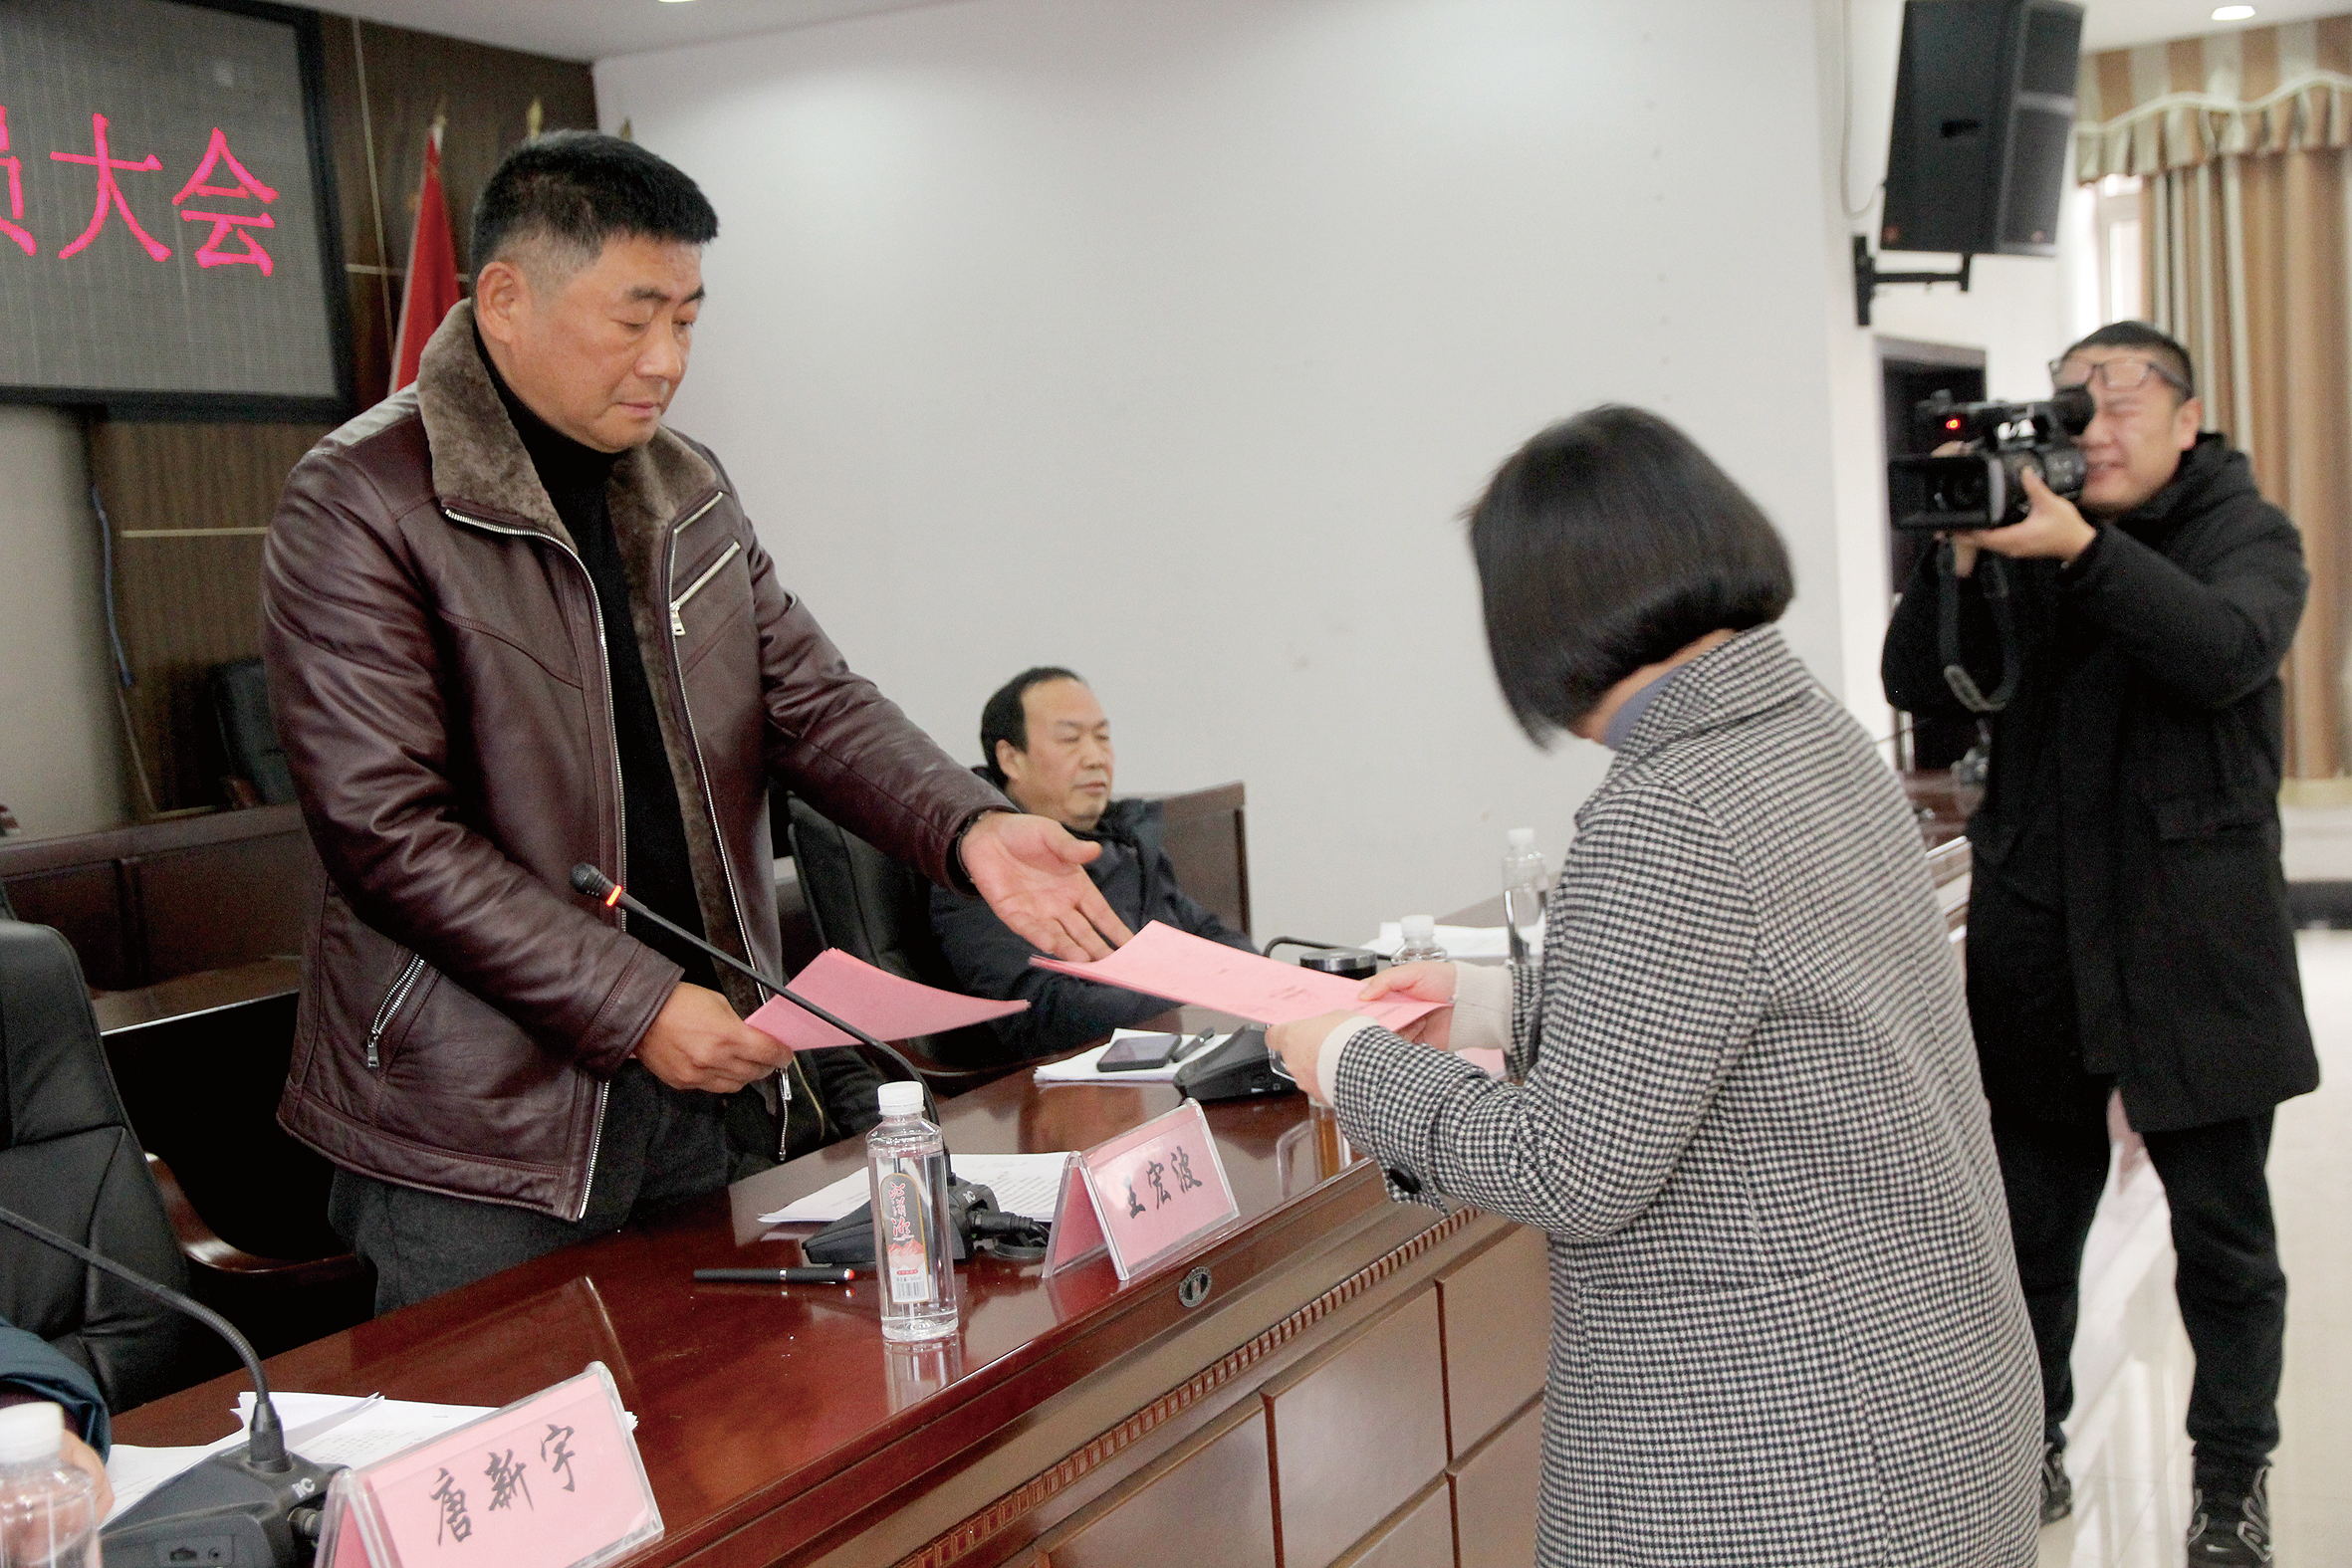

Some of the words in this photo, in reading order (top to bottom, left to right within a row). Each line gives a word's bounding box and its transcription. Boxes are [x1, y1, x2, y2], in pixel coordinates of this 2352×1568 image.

[1125, 1145, 1203, 1220] 王宏波
[429, 1424, 576, 1546] 唐新宇
